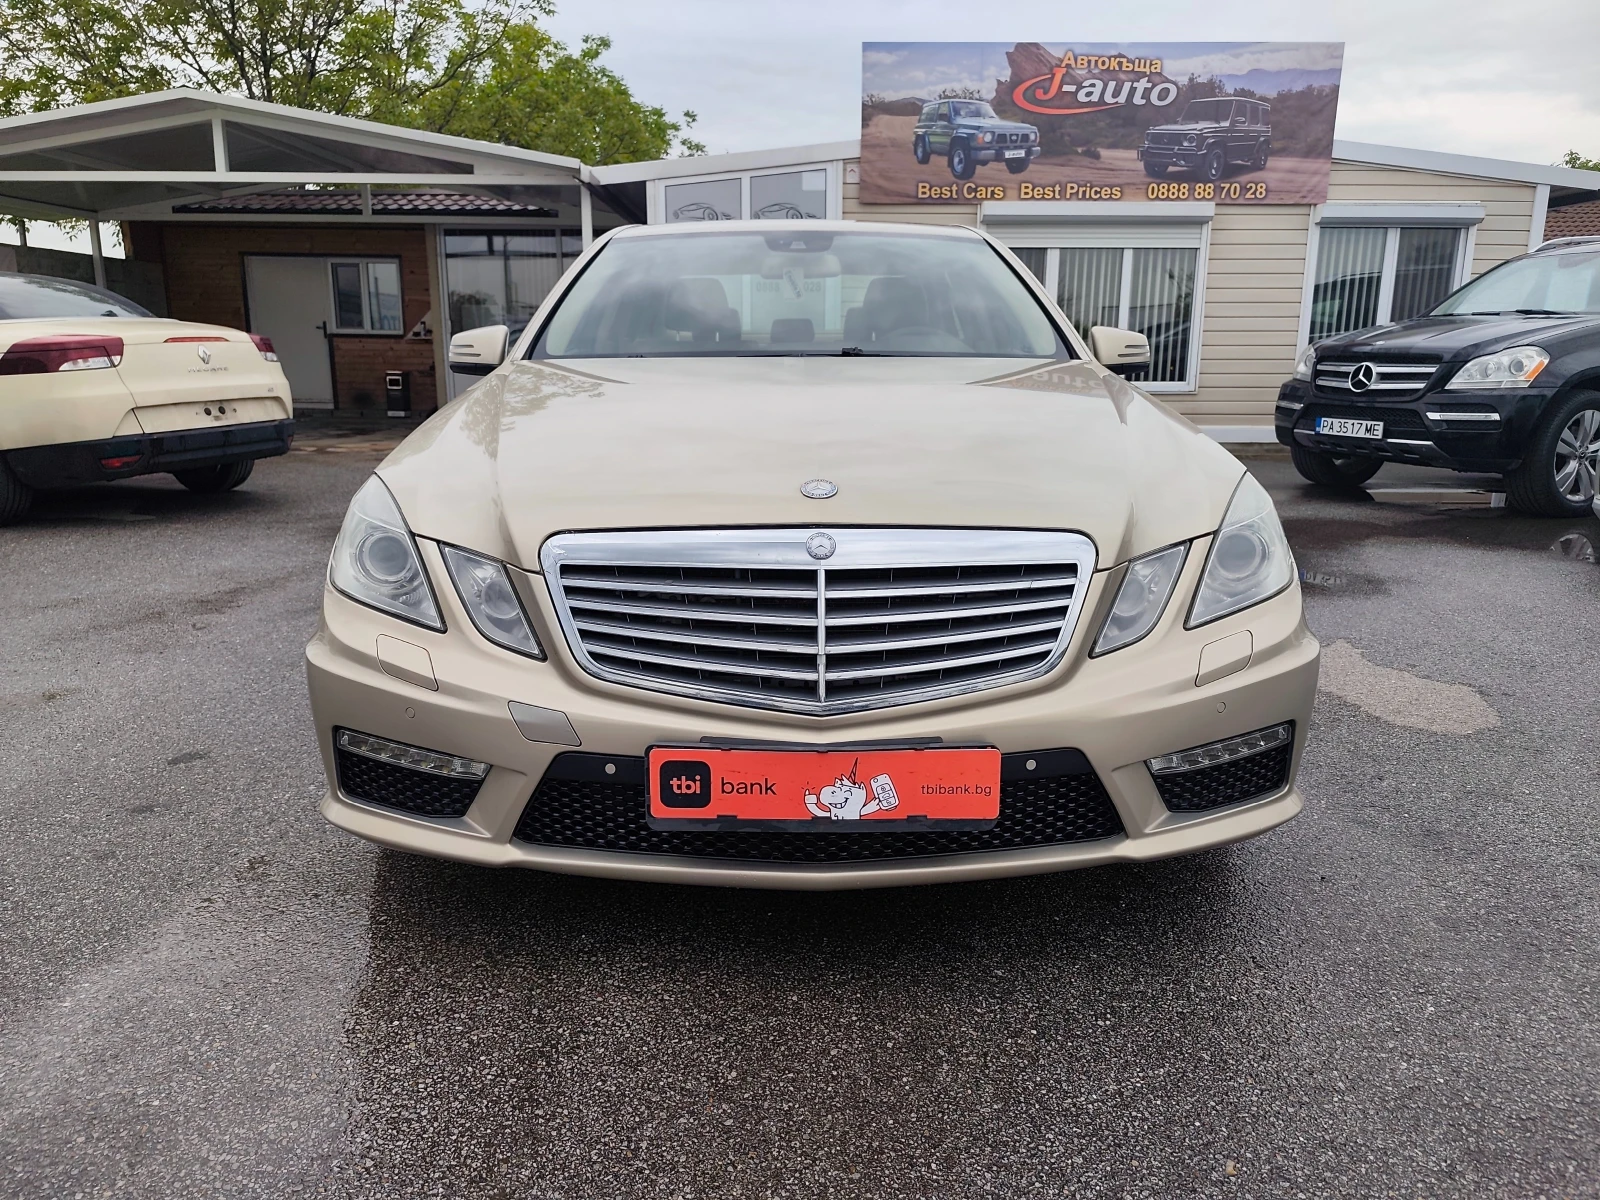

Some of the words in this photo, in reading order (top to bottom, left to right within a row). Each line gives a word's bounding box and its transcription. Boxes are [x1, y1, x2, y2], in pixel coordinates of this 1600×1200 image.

[1061, 51, 1162, 74] Автокъща
[1034, 67, 1178, 106] J-auto
[917, 183, 958, 199] Best
[963, 183, 1004, 199] Cars
[1020, 183, 1061, 199] Best
[1065, 183, 1122, 199] Prices
[1147, 183, 1189, 199] 0888
[1194, 183, 1215, 199] 88
[1220, 183, 1240, 199] 70
[1244, 183, 1267, 199] 28
[1336, 421, 1363, 435] 3517
[669, 775, 701, 794] tbi
[721, 777, 777, 795] bank
[921, 784, 992, 797] tbibank.bg
